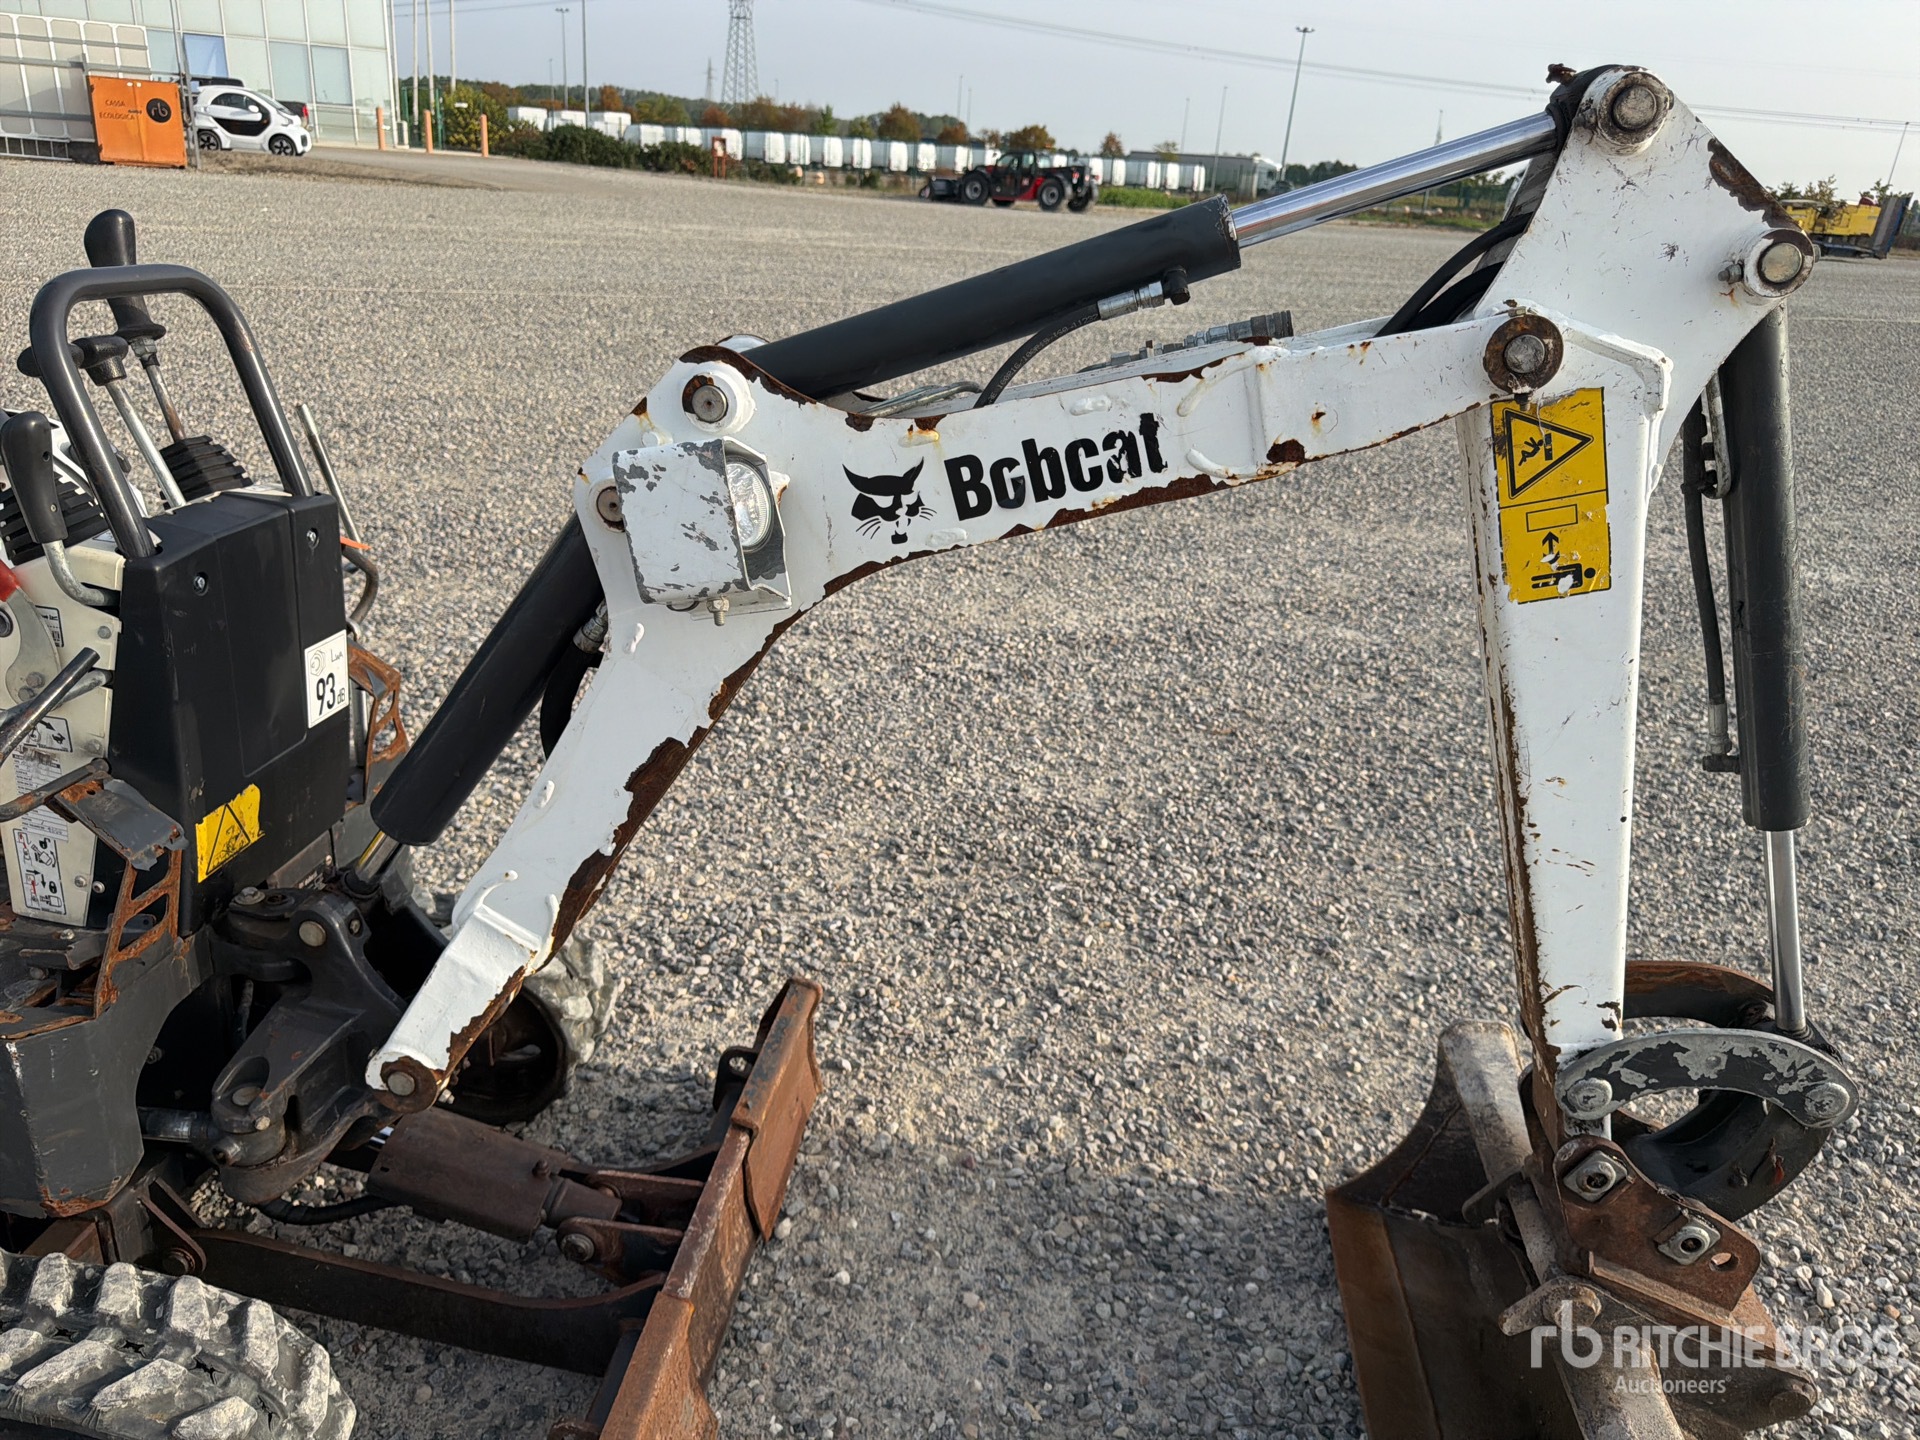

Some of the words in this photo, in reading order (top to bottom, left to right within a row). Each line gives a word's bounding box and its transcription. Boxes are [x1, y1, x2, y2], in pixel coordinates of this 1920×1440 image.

[944, 412, 1168, 522] Bobcat
[316, 672, 336, 716] 93
[337, 688, 345, 704] dB
